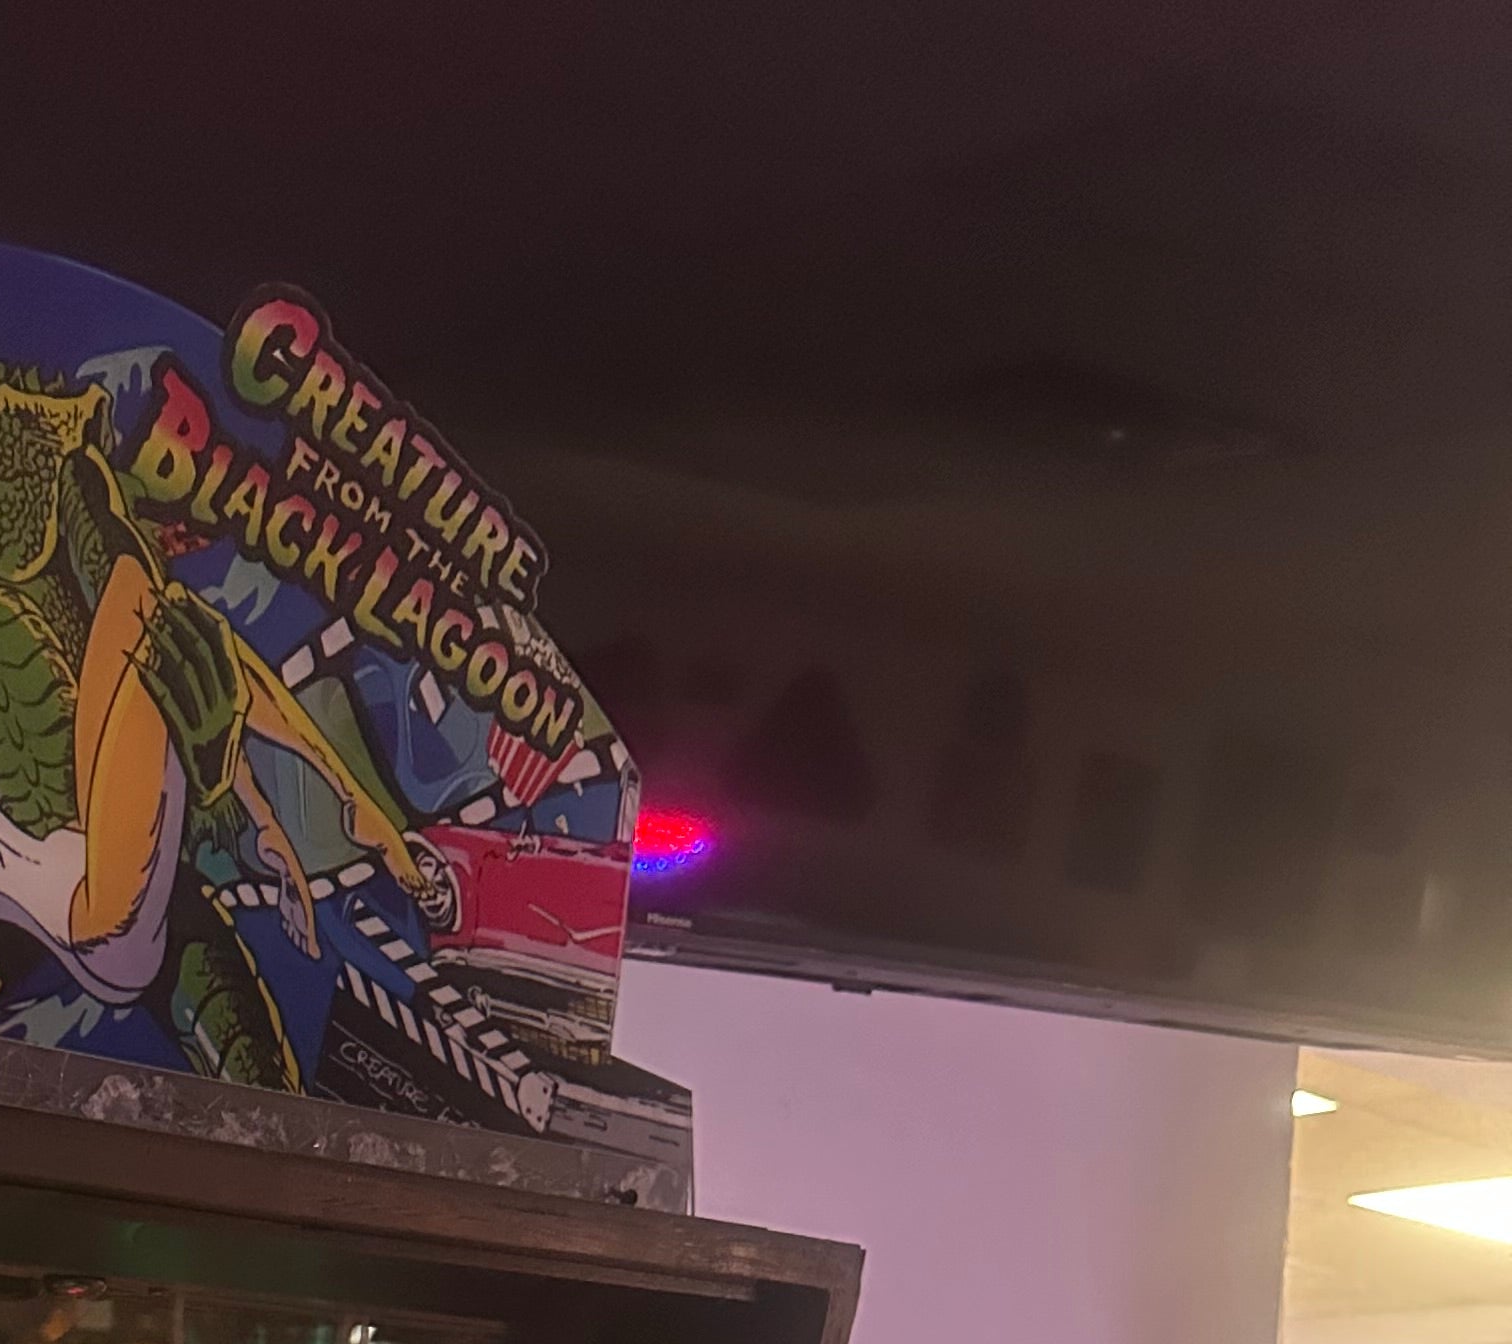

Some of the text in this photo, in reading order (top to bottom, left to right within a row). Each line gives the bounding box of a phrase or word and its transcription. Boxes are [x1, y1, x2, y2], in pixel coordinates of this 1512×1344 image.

[134, 370, 575, 748] BLACK LAGOON
[232, 298, 537, 601] CREATURE
[287, 438, 469, 589] FROM THE
[339, 1042, 429, 1113] CREATURE
